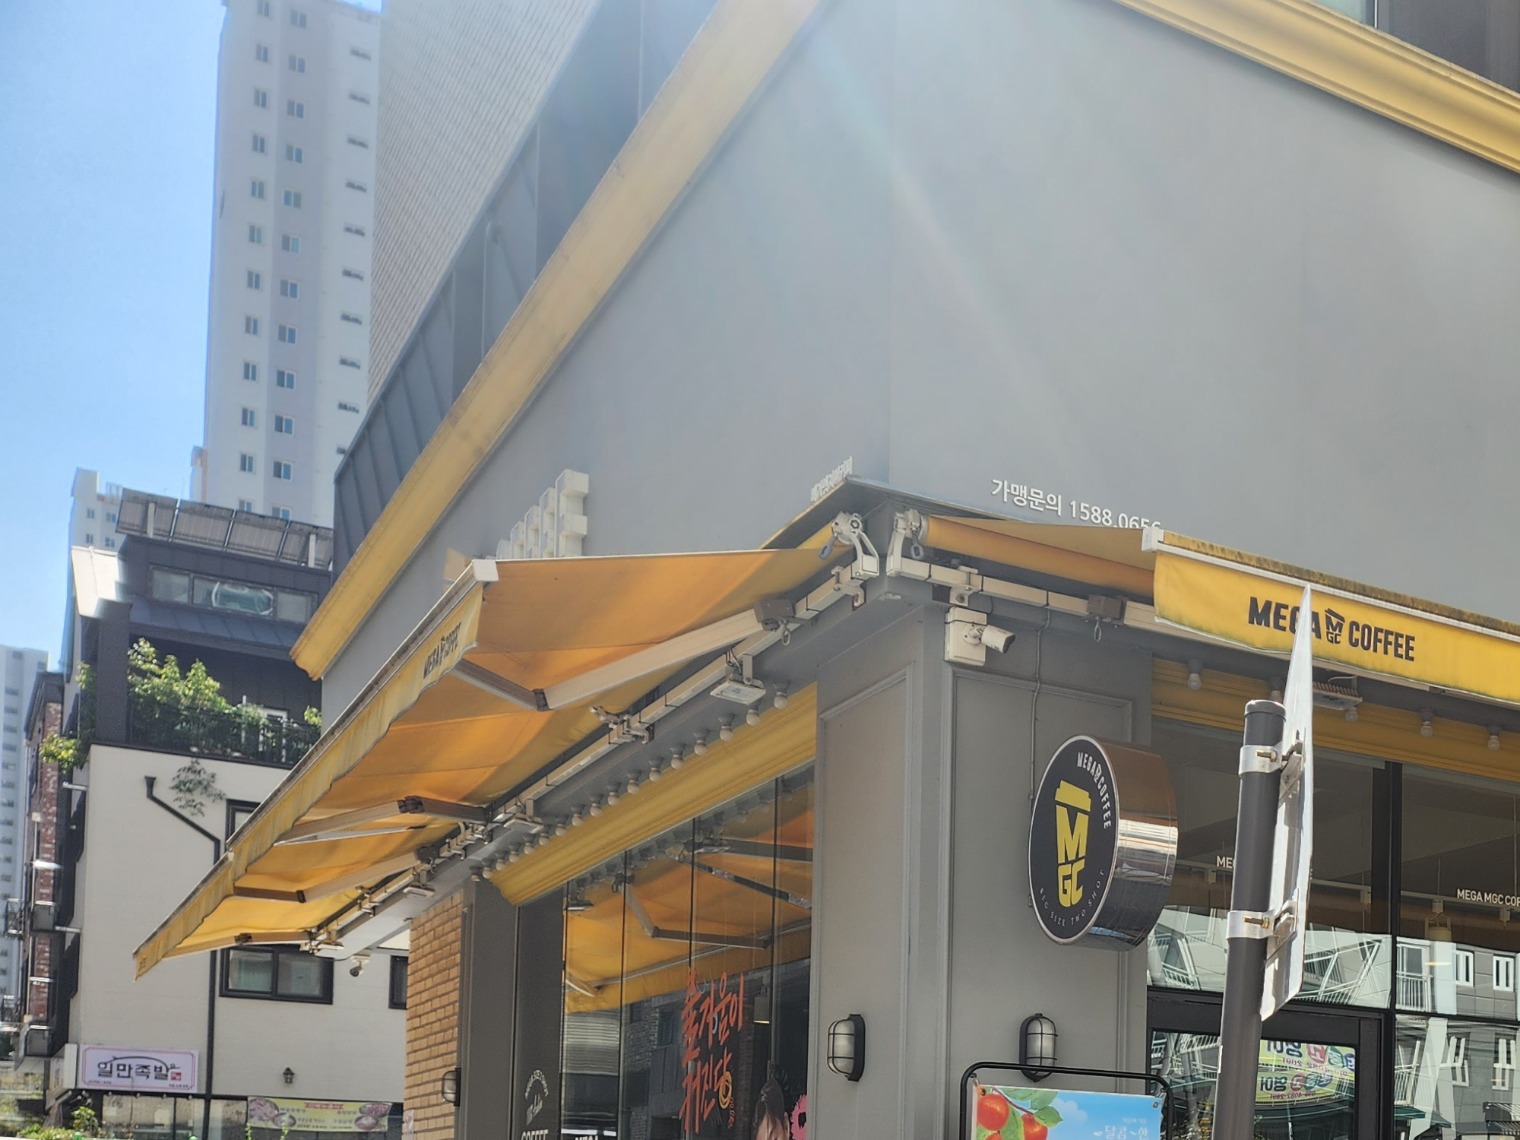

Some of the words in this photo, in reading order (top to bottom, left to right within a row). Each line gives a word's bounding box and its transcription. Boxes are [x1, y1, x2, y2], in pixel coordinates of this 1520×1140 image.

[991, 479, 1062, 517] 가맹문의
[1349, 620, 1416, 662] COFFEE
[1077, 752, 1097, 777] MEGA
[1099, 776, 1112, 829] COFFEE
[1457, 889, 1483, 903] MEGA
[1484, 892, 1504, 905] MGC
[1050, 911, 1067, 927] SIZE
[1071, 909, 1087, 926] TWO
